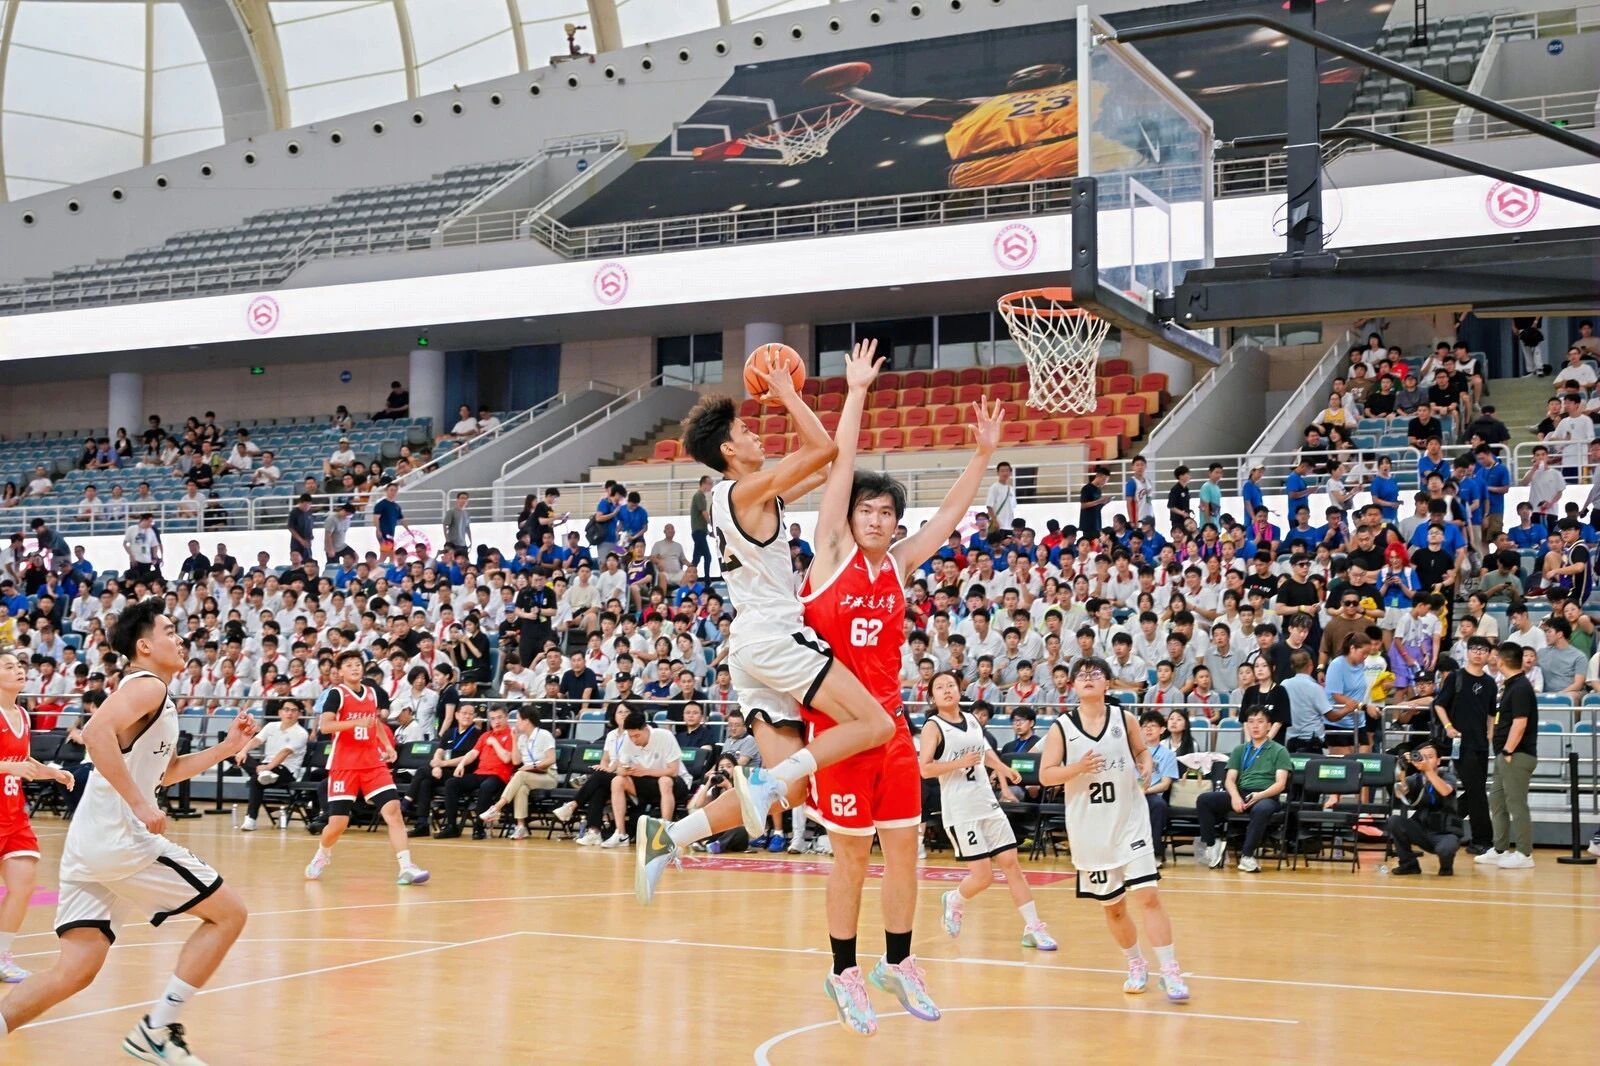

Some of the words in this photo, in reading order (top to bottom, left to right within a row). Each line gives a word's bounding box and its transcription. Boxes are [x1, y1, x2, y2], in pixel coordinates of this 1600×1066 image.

[1008, 96, 1072, 117] 23
[850, 617, 883, 647] 62
[354, 726, 369, 740] 81
[965, 765, 976, 781] 2
[4, 775, 20, 796] 85
[333, 781, 345, 793] 81
[1089, 781, 1115, 804] 20
[830, 793, 857, 816] 62
[967, 830, 978, 846] 2
[1088, 870, 1108, 884] 20
